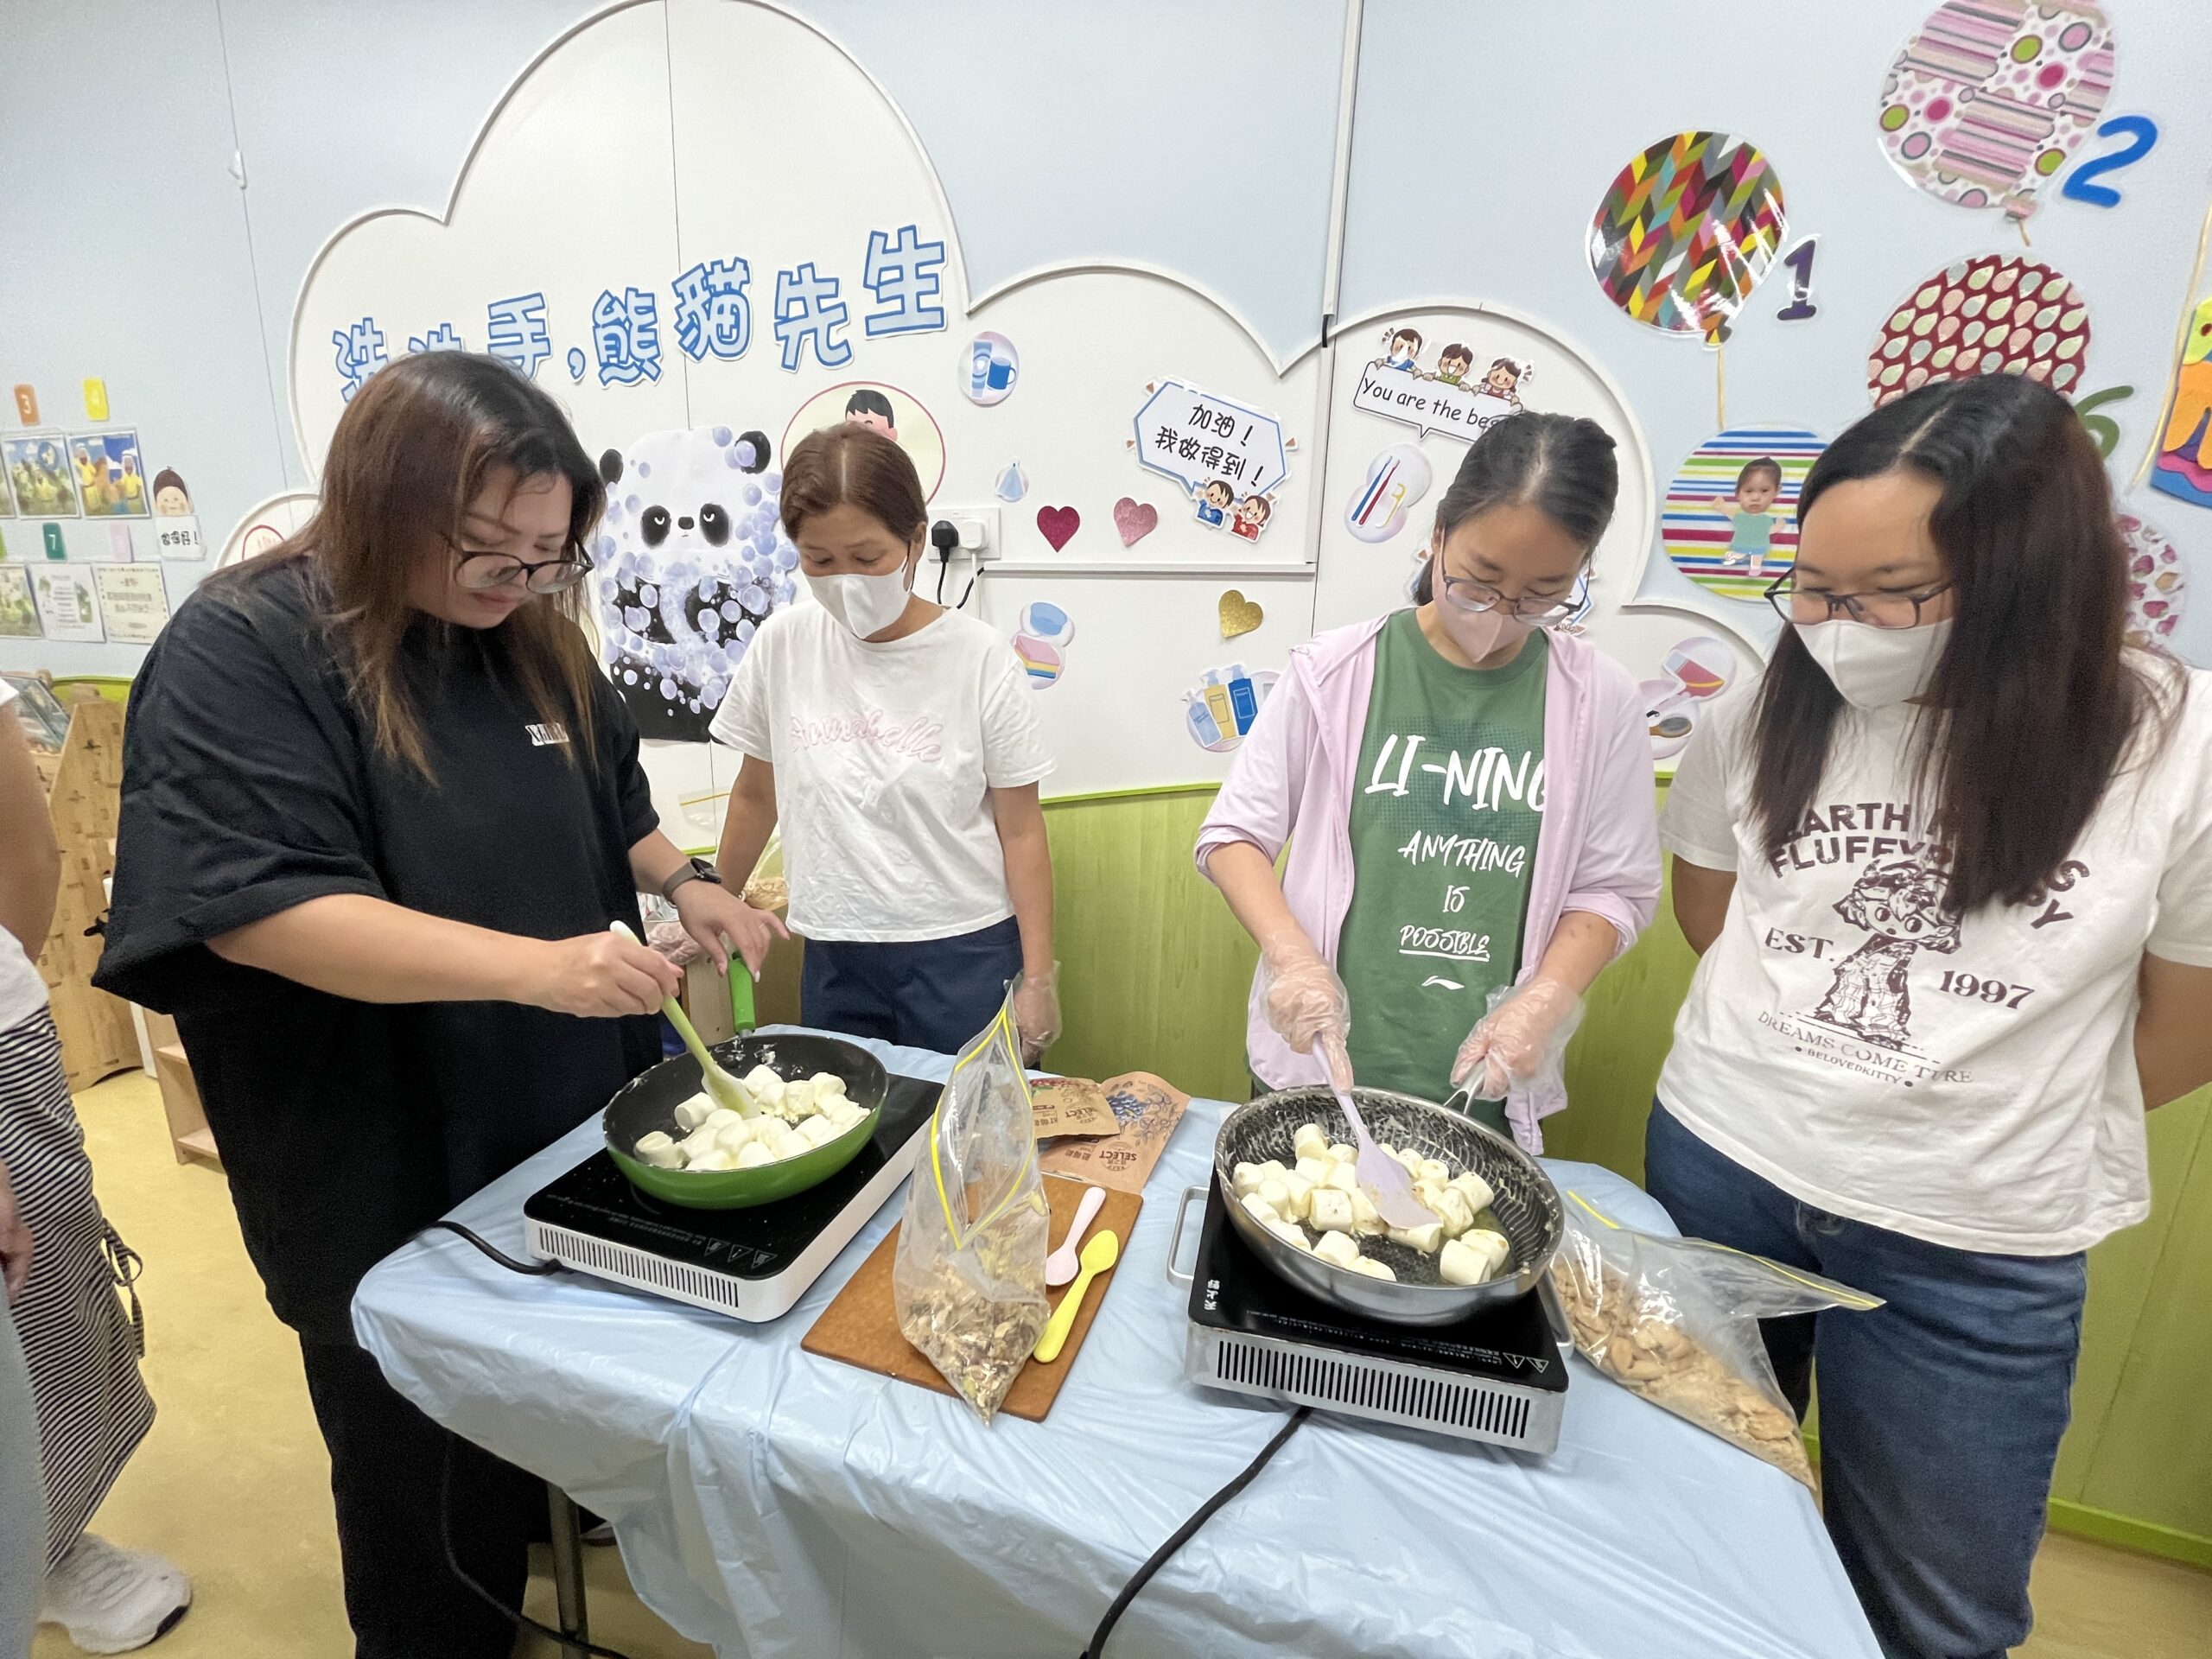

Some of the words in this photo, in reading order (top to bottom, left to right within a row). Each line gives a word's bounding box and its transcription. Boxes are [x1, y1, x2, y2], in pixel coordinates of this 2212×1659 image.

[2062, 115, 2158, 207] 2
[1777, 239, 1818, 320] 1
[21, 394, 31, 415] 3
[1363, 376, 1393, 402] You
[1396, 390, 1427, 410] are
[1432, 398, 1460, 422] the
[1466, 407, 1499, 429] be
[1192, 404, 1254, 447] 加油！
[1155, 426, 1264, 487] 我做得到！
[48, 533, 56, 550] 7
[1787, 802, 1912, 842] ARTH
[1397, 830, 1526, 878] ANYTHING
[1442, 885, 1471, 912] IS
[1398, 925, 1491, 959] POSSIBLE
[1764, 926, 1836, 963] EST.
[1938, 969, 2035, 1010] 1997
[1758, 1010, 1835, 1051] DREAMS
[1841, 1043, 1910, 1072] COME
[1807, 1048, 1903, 1084] BELOVEDKITTY
[1098, 1149, 1138, 1161] SELECT
